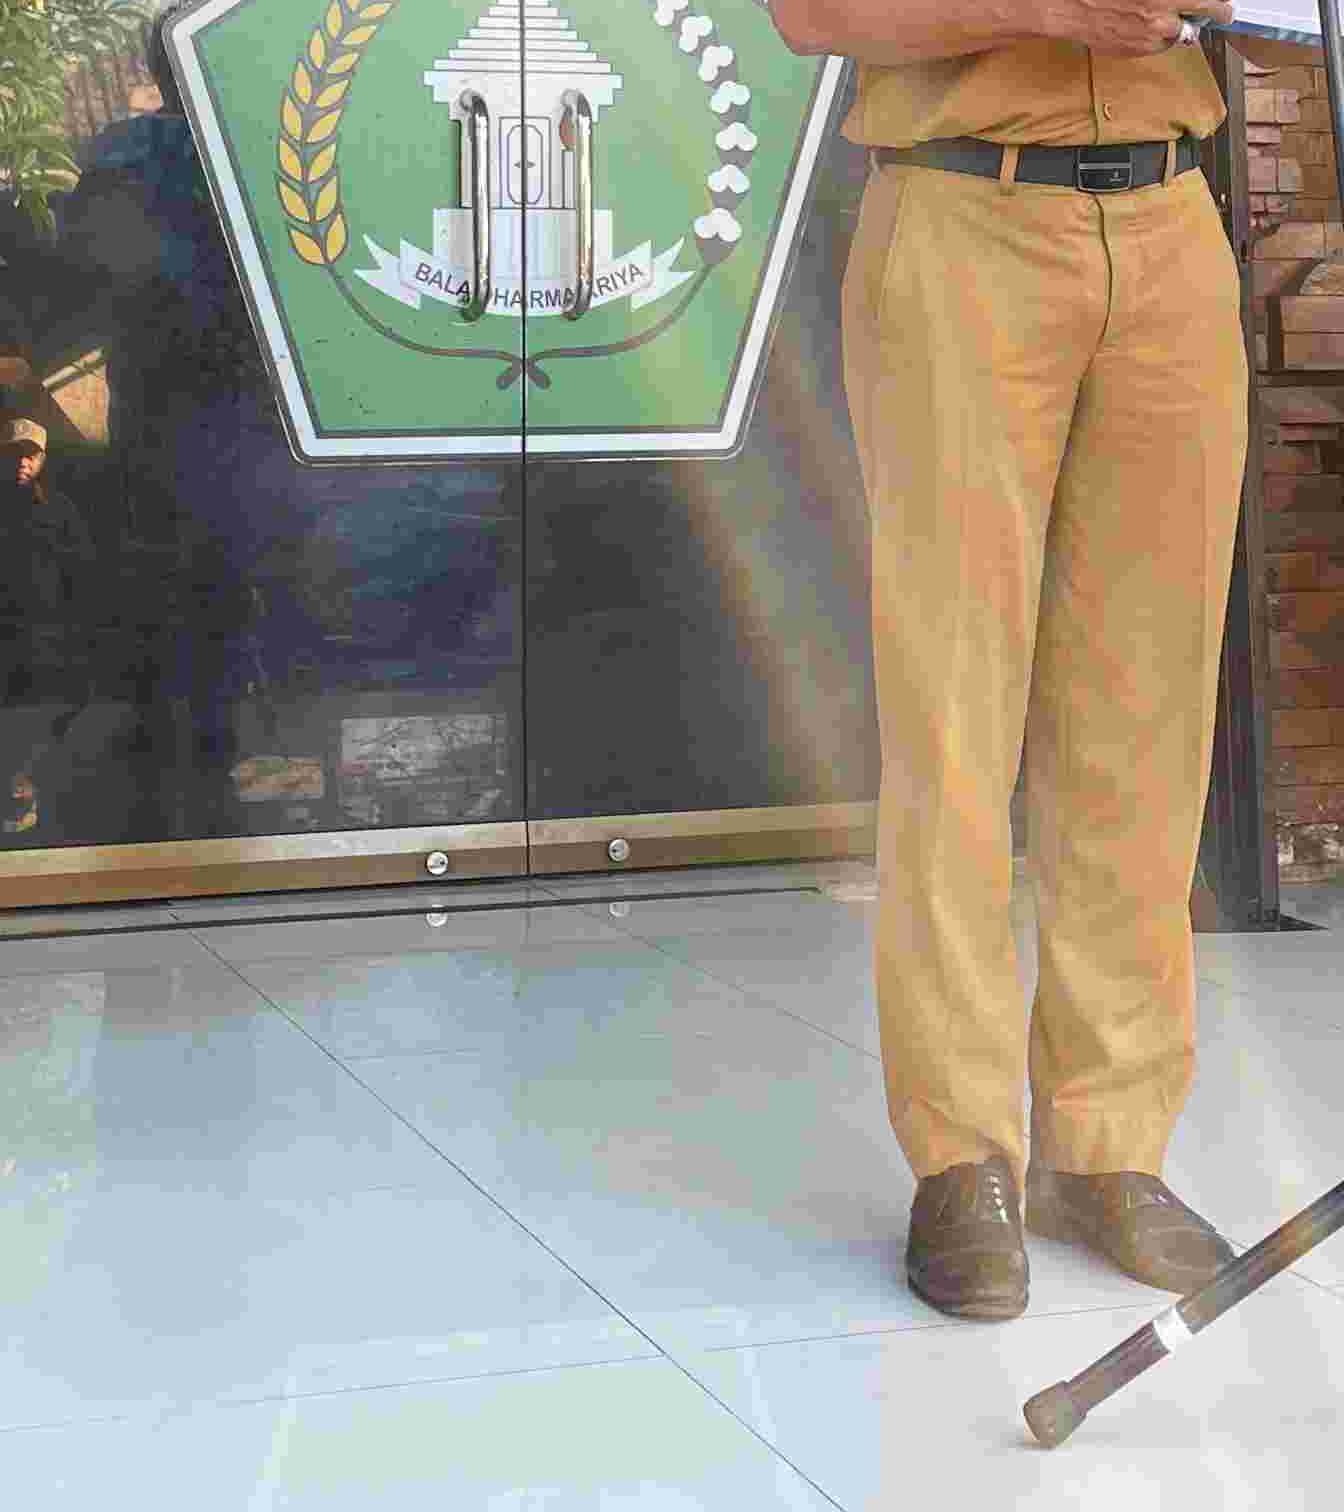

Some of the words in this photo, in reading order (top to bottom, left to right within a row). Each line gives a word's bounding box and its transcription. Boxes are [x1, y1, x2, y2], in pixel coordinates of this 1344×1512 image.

[415, 262, 471, 301] BALA
[492, 287, 578, 310] HARMA
[592, 264, 643, 299] RIYA
